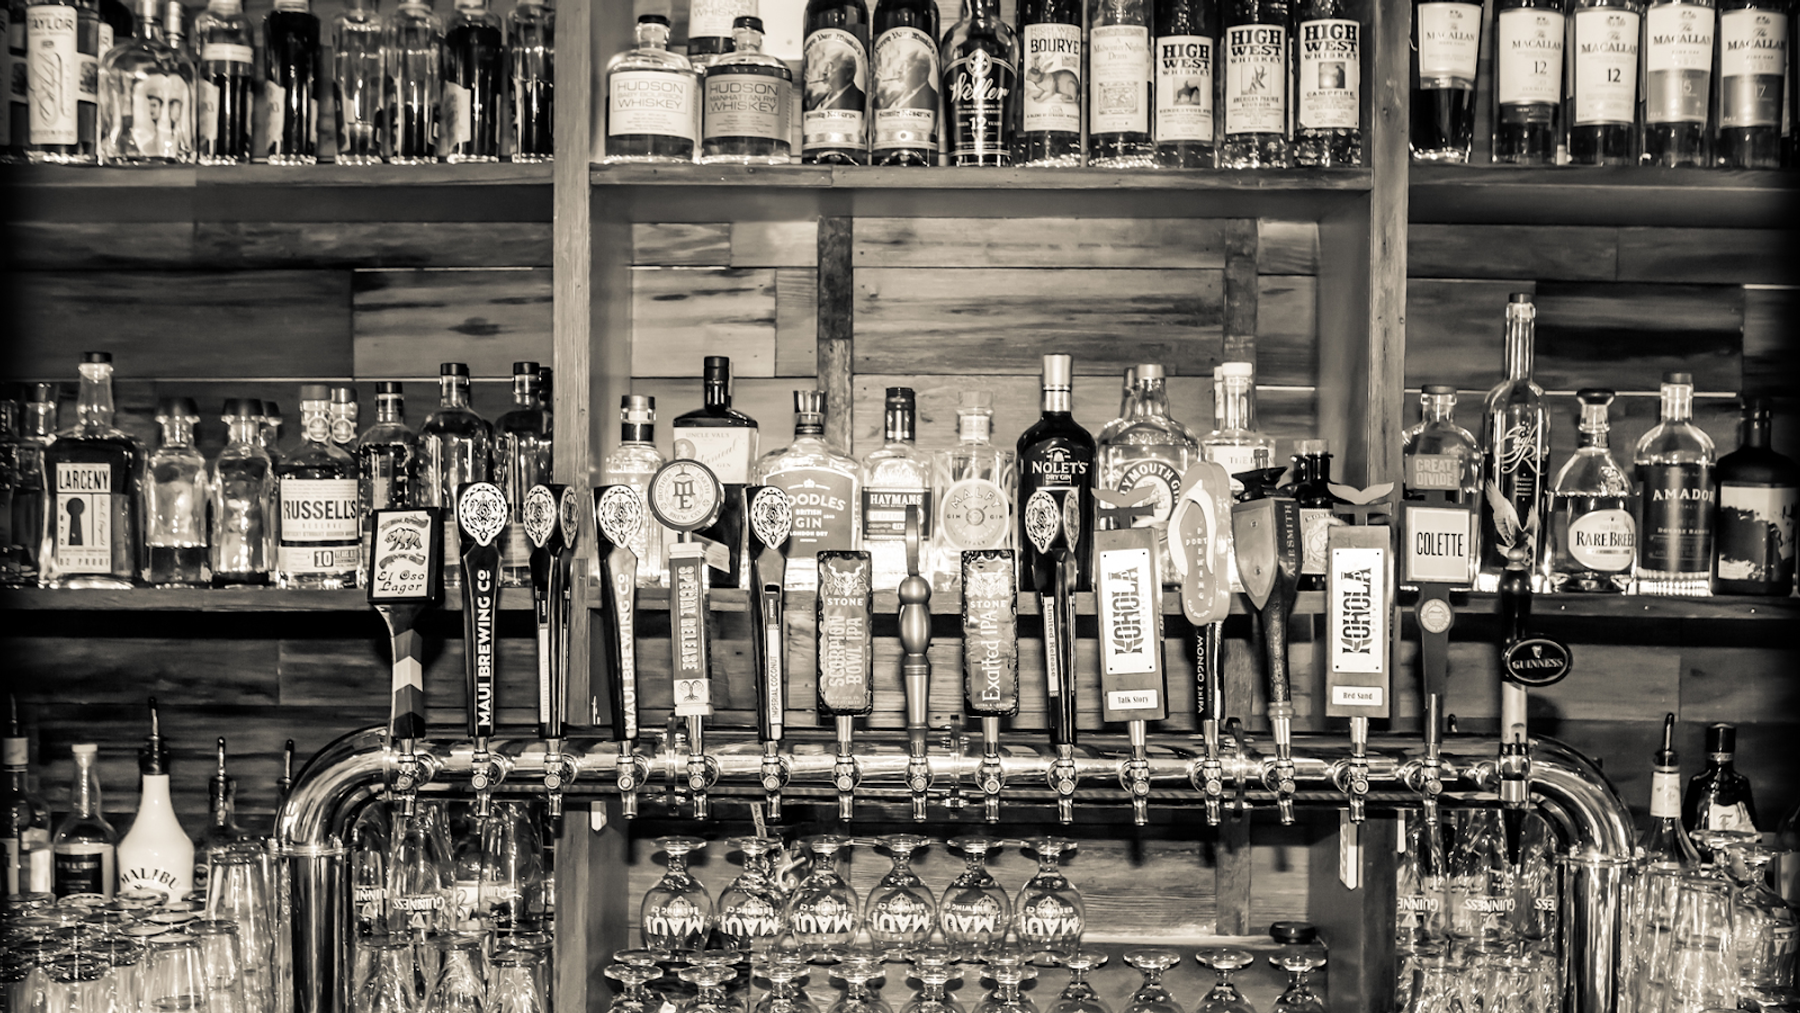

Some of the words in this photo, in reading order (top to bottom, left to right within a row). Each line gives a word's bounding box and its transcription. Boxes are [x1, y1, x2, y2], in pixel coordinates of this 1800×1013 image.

[1231, 29, 1282, 45] HIGH
[1304, 23, 1357, 41] HIGH
[1653, 34, 1711, 46] MACALLAN
[1030, 38, 1080, 55] BOURYE
[1162, 43, 1210, 59] HIGH
[1231, 45, 1283, 57] WEST
[1304, 40, 1358, 53] WEST
[1512, 40, 1562, 50] MACALLAN
[1581, 41, 1638, 55] MACALLAN
[1727, 39, 1787, 52] MACALLAN
[1163, 58, 1211, 69] WEST
[1231, 56, 1282, 64] WHISKEY
[1304, 52, 1358, 60] WHISKEY
[1534, 60, 1547, 75] 12
[1607, 68, 1621, 83] 12
[617, 80, 684, 95] HUDSON
[710, 82, 779, 96] HUDSON
[949, 72, 1010, 103] Weller
[617, 98, 682, 110] WHISKEY
[710, 101, 777, 112] WHISKEY
[969, 116, 988, 130] 12
[1032, 460, 1088, 474] NOLET'S
[1415, 458, 1450, 473] GREAT
[59, 470, 109, 490] LARCENY
[1120, 462, 1174, 496] LYMOUTH
[1416, 472, 1453, 487] DIVIDE
[787, 493, 847, 512] OODLES
[950, 486, 1002, 510] MALFY
[283, 500, 356, 520] RUSSELL'S
[795, 517, 822, 529] GIN
[1185, 537, 1208, 546] PORT
[1284, 504, 1297, 577] ALESMITH
[1416, 532, 1464, 557] COLETTE
[1575, 530, 1608, 547] RARE
[315, 551, 332, 567] 10
[377, 571, 394, 581] El
[399, 569, 425, 581] Oso
[378, 581, 423, 595] Lager
[678, 565, 696, 616] SPECIAL
[827, 597, 864, 607] STONE
[970, 599, 1007, 609] STONE
[980, 608, 999, 636] IPA
[1046, 603, 1054, 638] Limited
[477, 595, 492, 677] BREWING
[846, 616, 863, 642] IPA
[620, 599, 634, 684] BREWING
[681, 617, 699, 671] RELEASE
[828, 615, 846, 687] SCORPION
[1195, 635, 1206, 683] MONGO
[769, 655, 780, 687] COCONUT
[846, 646, 864, 686] BOWL
[982, 640, 1001, 702] Exalted
[1511, 658, 1565, 670] GUINNESS
[477, 681, 492, 726] MAUI
[771, 687, 781, 719] IMPERIAL
[1117, 696, 1131, 704] Talk
[1343, 691, 1355, 699] Red
[1357, 691, 1373, 700] Sand
[622, 689, 637, 735] MAUI
[120, 867, 181, 891] MALIBU
[392, 897, 446, 912] GUINNESS
[1397, 898, 1439, 912] GUINNE
[1465, 897, 1516, 912] GUINNESS
[645, 915, 705, 936] MAUI
[721, 915, 780, 936] MAUI
[795, 913, 853, 934] MAUI
[872, 912, 930, 933] MAUI
[943, 912, 995, 934] MAU
[1020, 915, 1079, 936] MAUI
